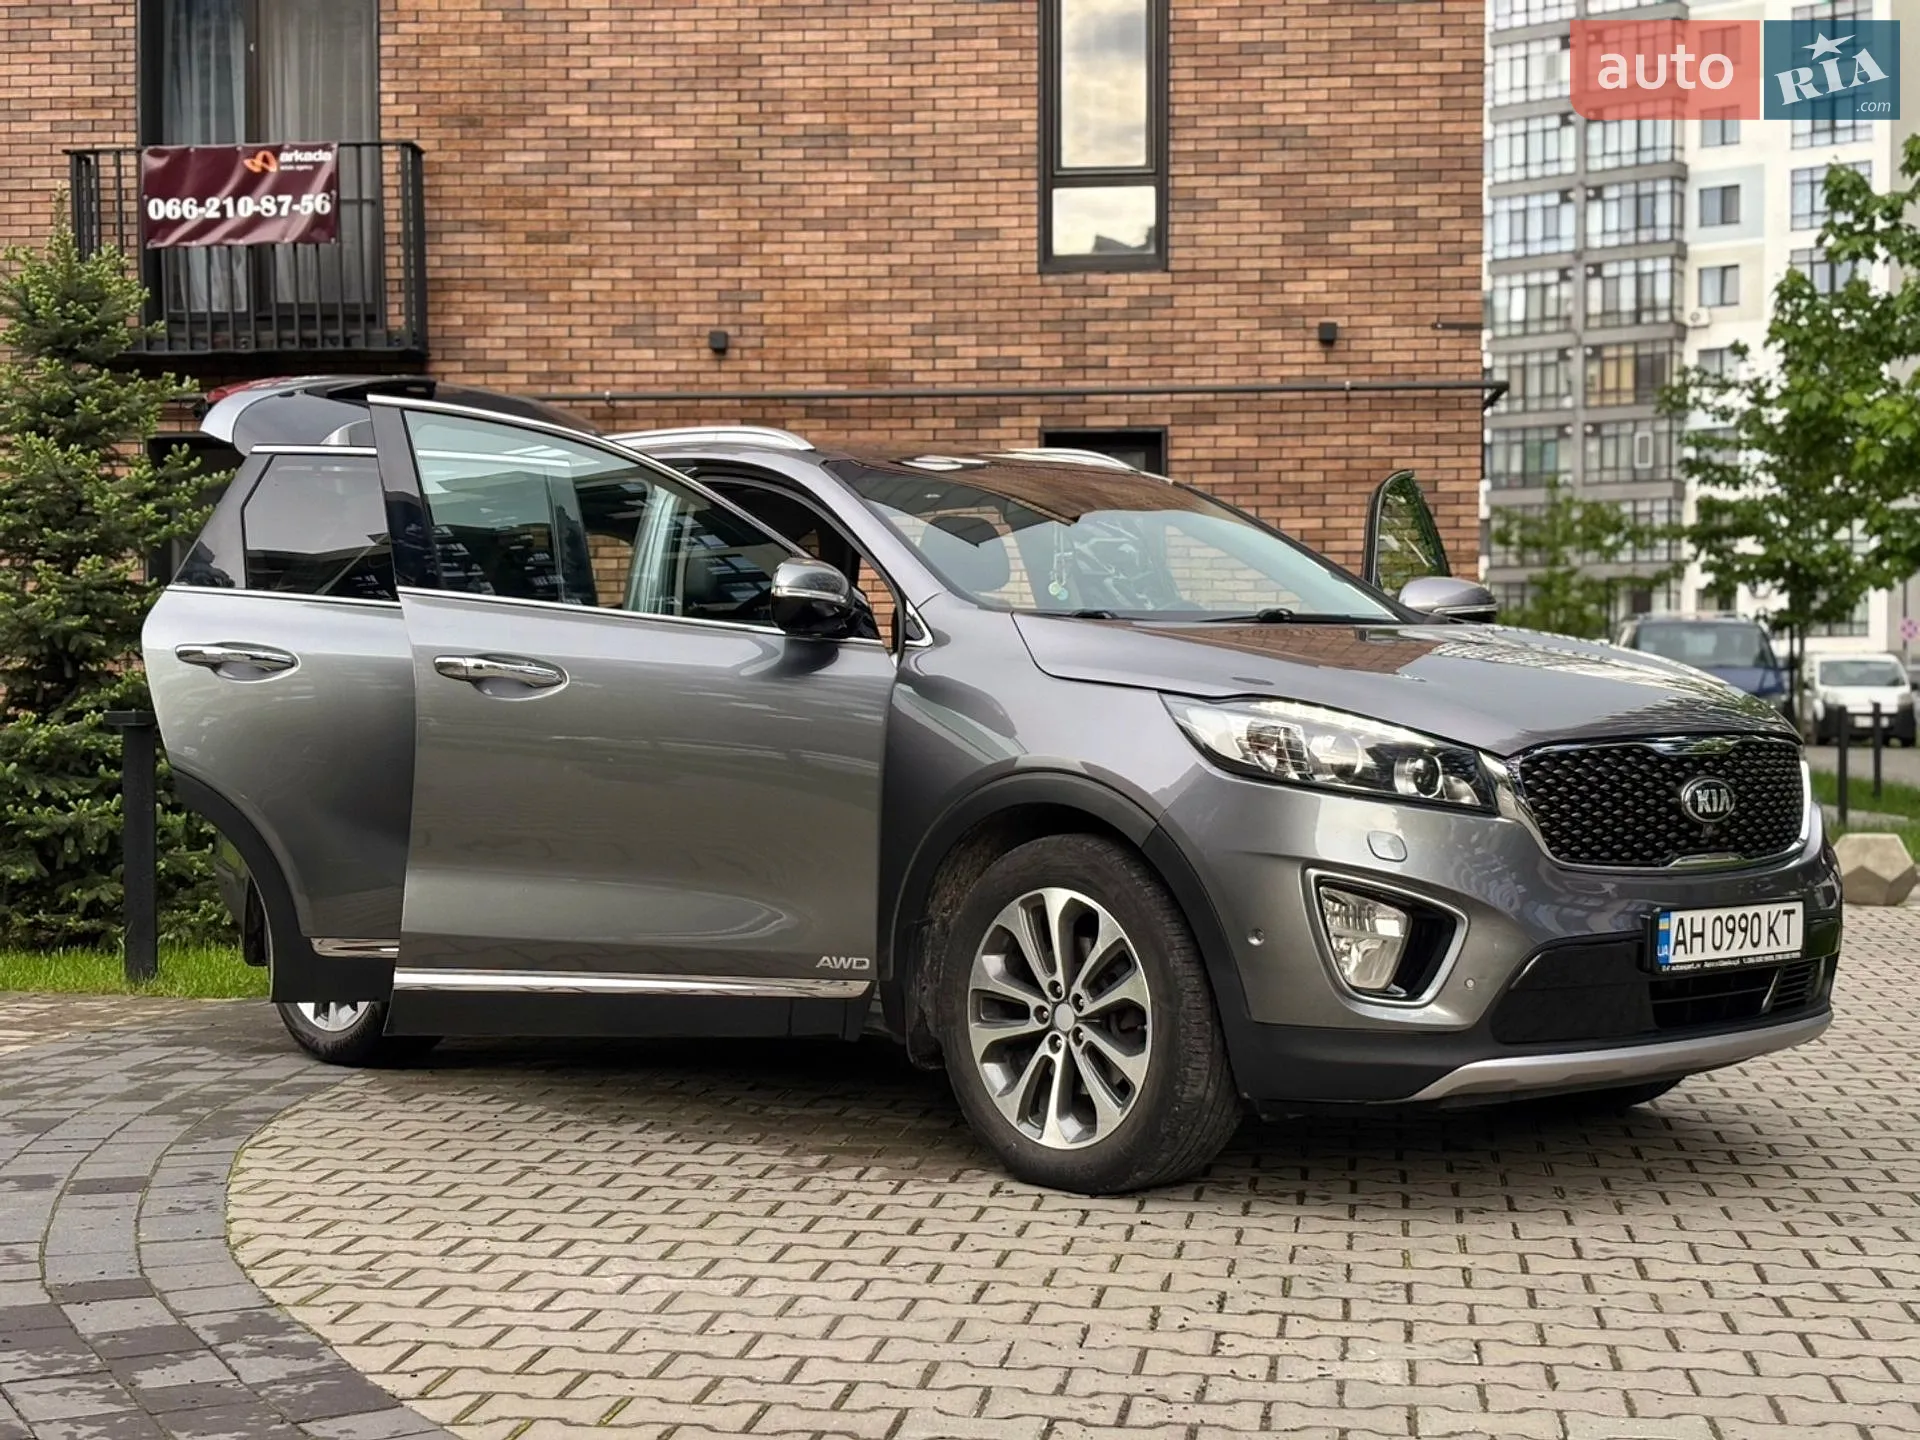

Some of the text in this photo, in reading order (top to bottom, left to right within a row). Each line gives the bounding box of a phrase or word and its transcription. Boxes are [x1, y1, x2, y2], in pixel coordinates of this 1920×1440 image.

[280, 149, 332, 162] arkada
[147, 193, 331, 220] 066-210-87-56
[1695, 788, 1730, 814] KIA
[1672, 908, 1796, 956] AH 0990 KT
[815, 955, 870, 970] AWD
